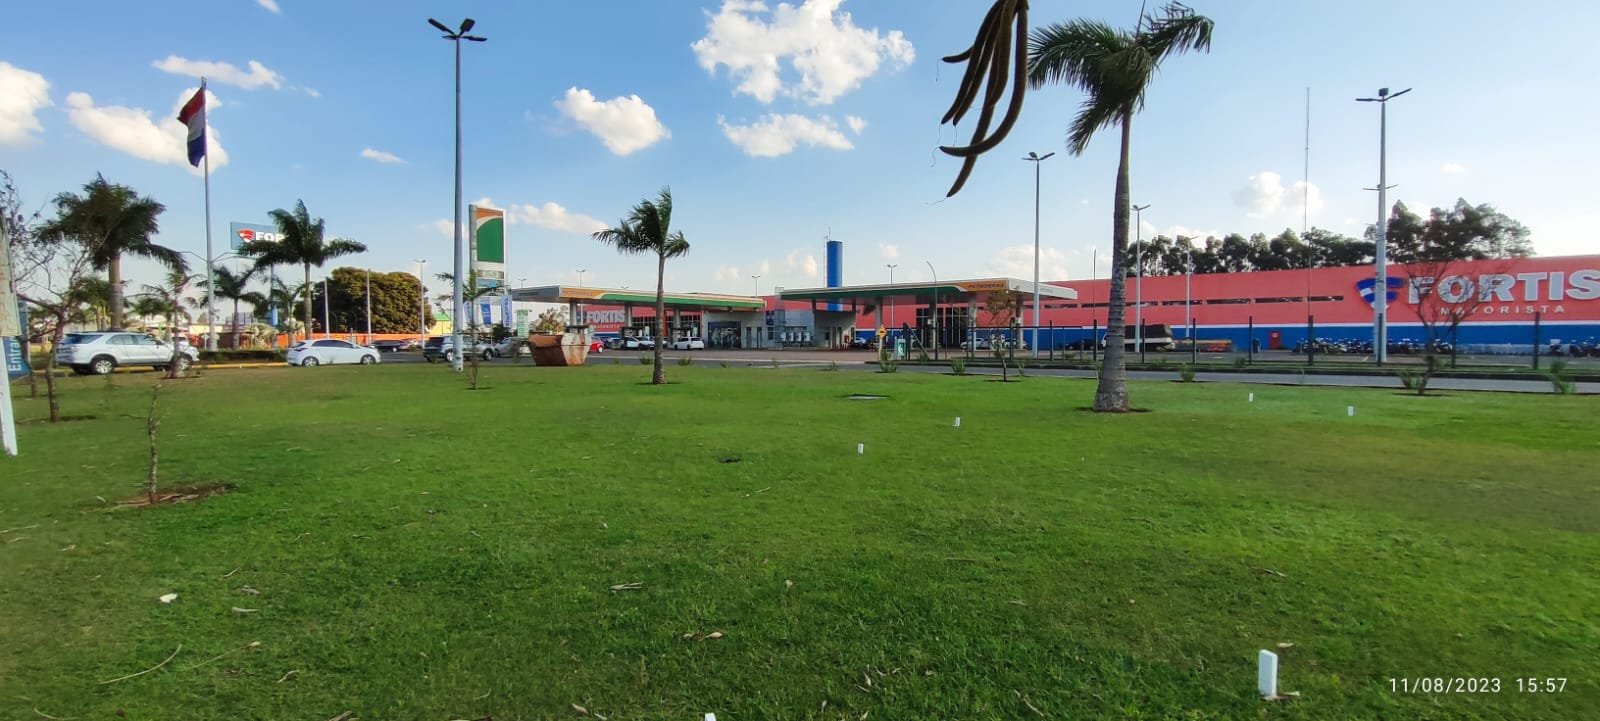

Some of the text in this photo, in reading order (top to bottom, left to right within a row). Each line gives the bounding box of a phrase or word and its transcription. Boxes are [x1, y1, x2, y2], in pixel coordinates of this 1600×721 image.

[1408, 269, 1600, 304] FORTIS
[586, 310, 625, 324] FORTIS
[1440, 304, 1565, 316] MAYORISTA
[7, 337, 22, 371] Entra
